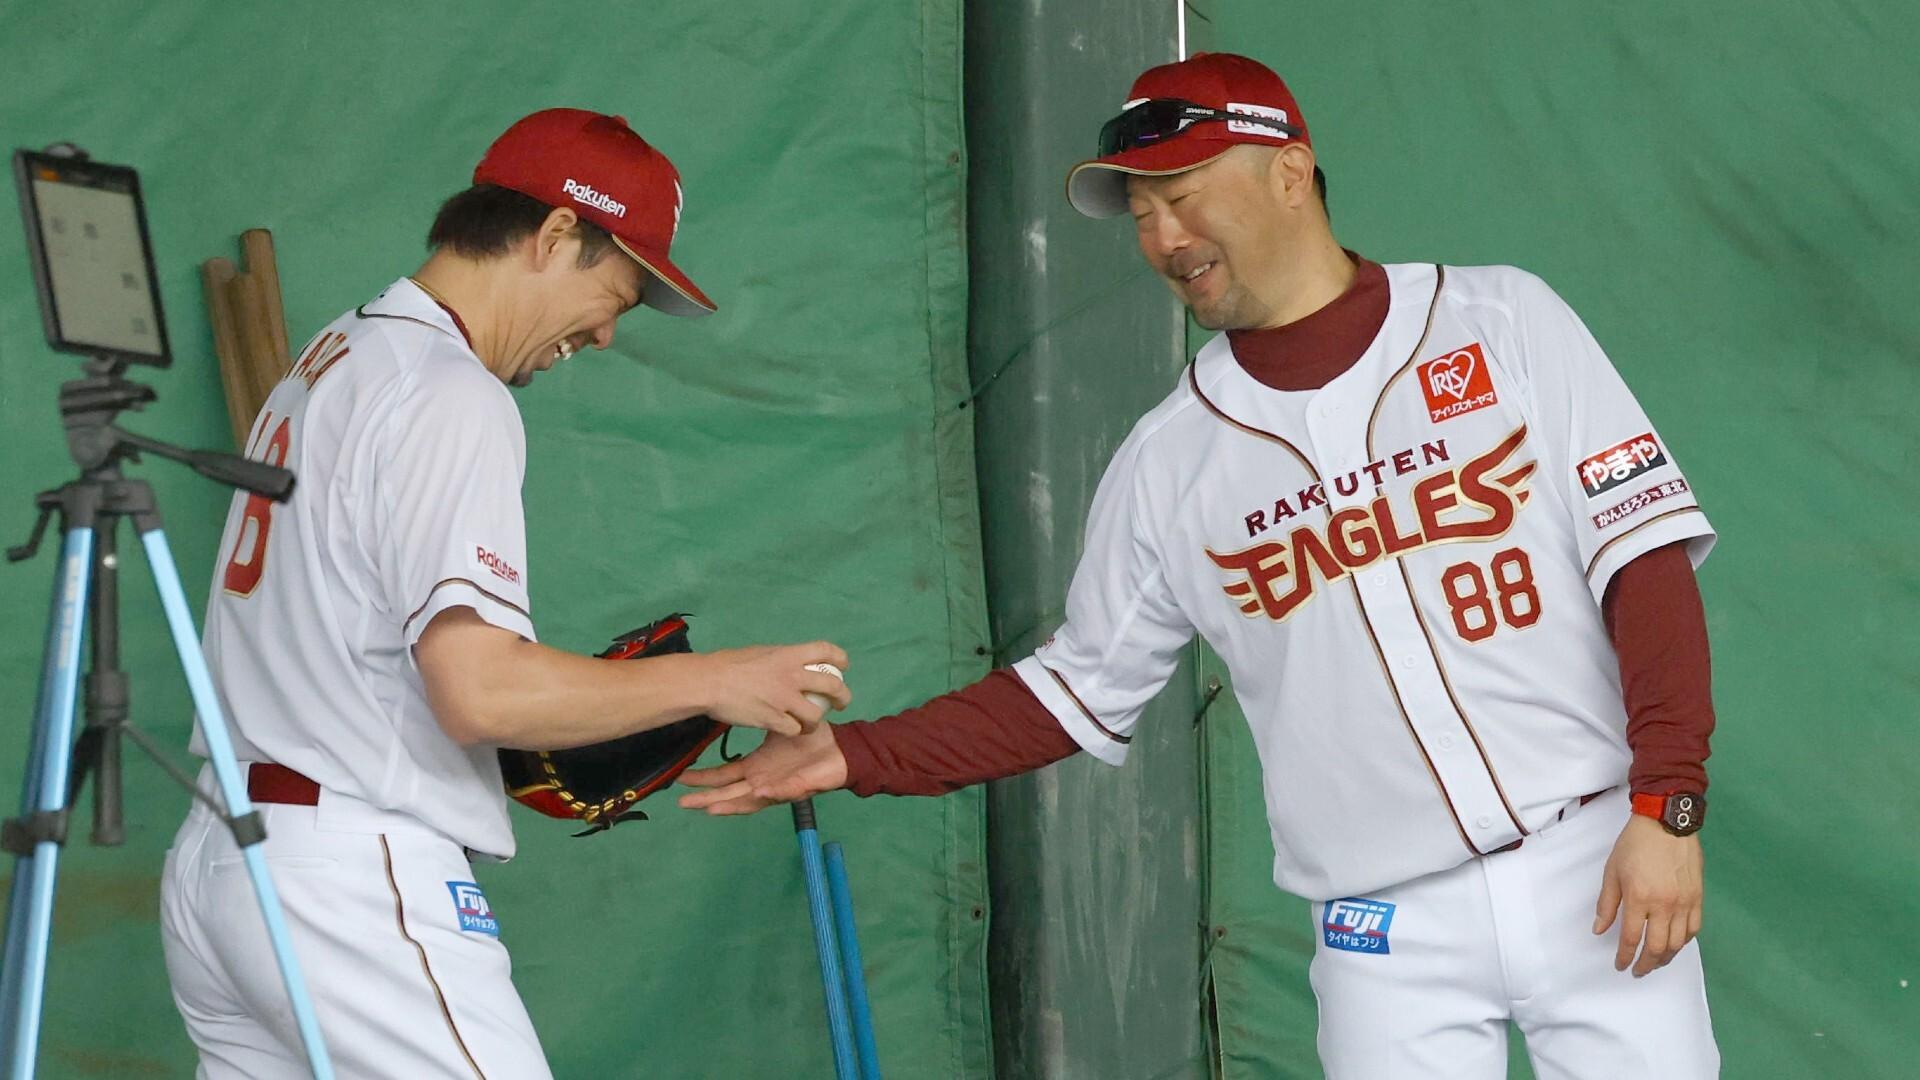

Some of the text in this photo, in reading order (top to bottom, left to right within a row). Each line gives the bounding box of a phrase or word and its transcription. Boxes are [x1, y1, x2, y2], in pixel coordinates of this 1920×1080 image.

[562, 178, 627, 219] Rakuten
[1431, 391, 1495, 422] アイリスオーヤマ
[1582, 438, 1659, 491] やまや
[1244, 439, 1451, 538] RAKUTEN
[1204, 419, 1538, 624] EAGLES
[476, 545, 521, 587] Rakuten
[1440, 547, 1544, 645] 88
[1327, 900, 1388, 934] Fuji
[1327, 931, 1381, 949] タイヤはフジ
